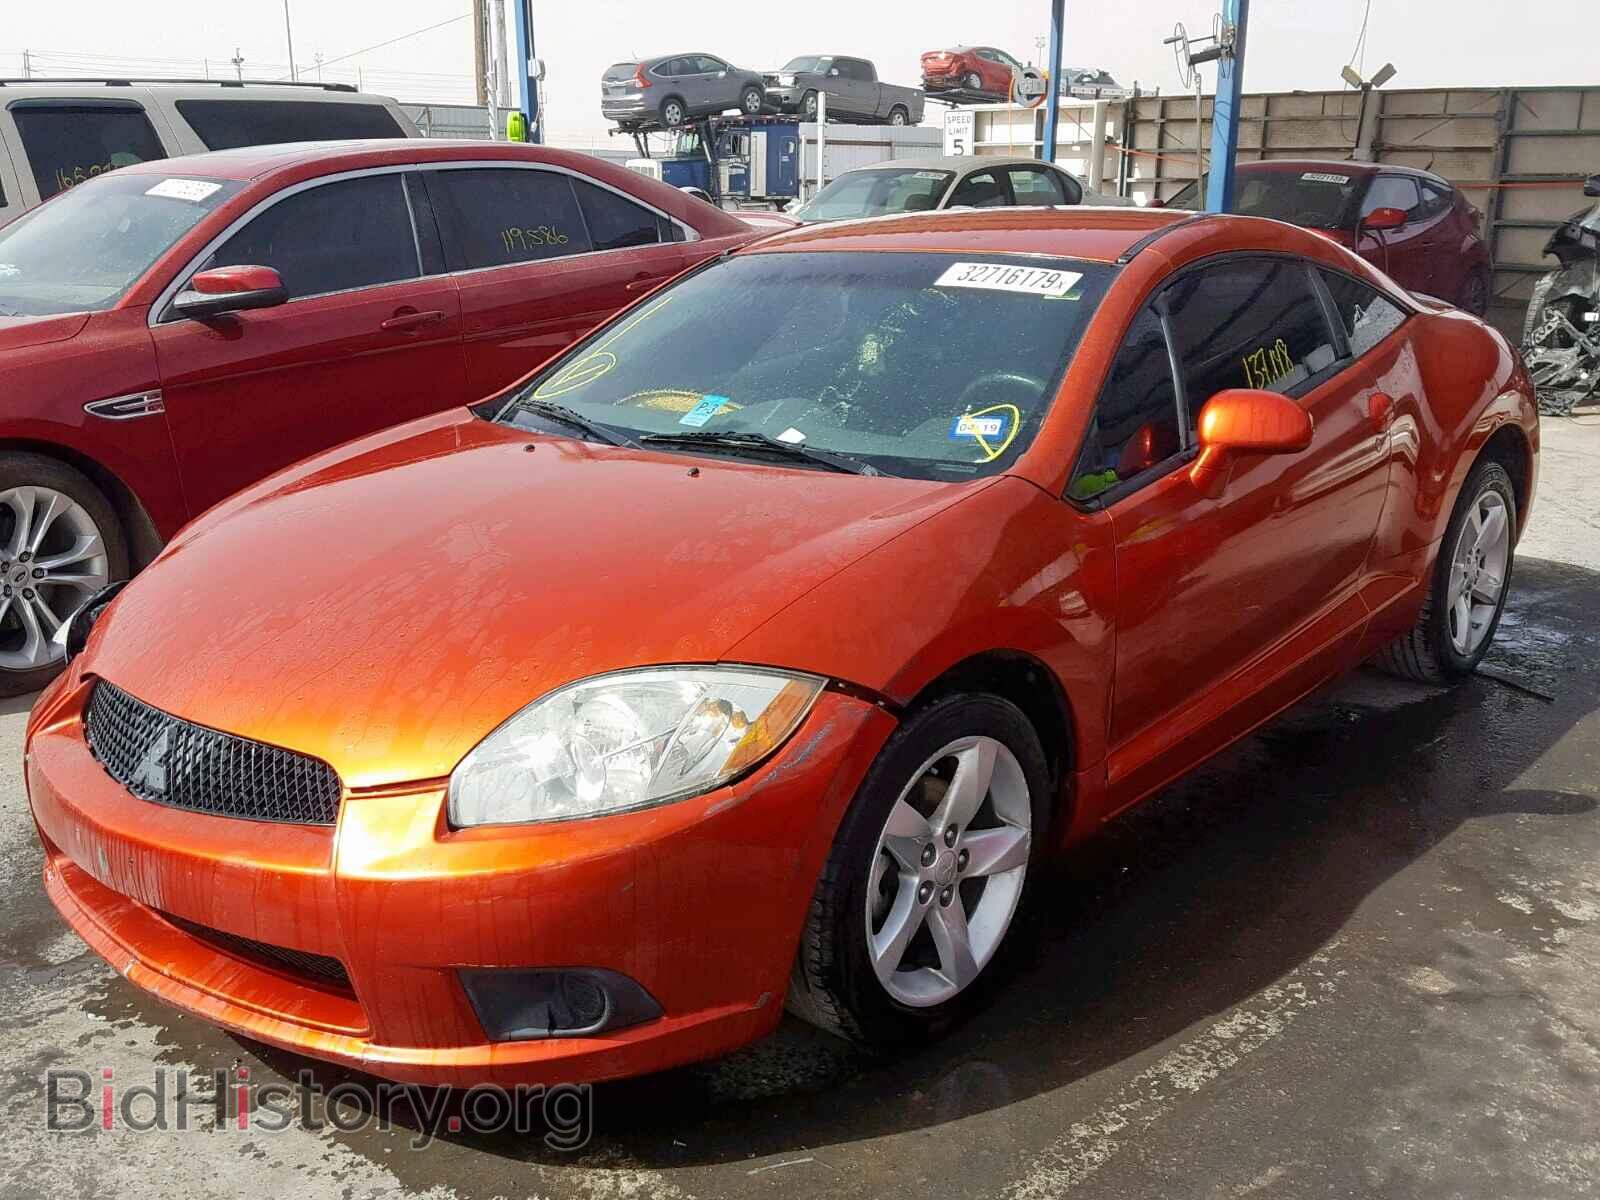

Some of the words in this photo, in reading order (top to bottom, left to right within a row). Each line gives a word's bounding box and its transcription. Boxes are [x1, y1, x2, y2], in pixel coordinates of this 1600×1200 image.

[947, 115, 972, 124] SPEED
[948, 127, 969, 136] LIMIT
[953, 139, 964, 156] 5
